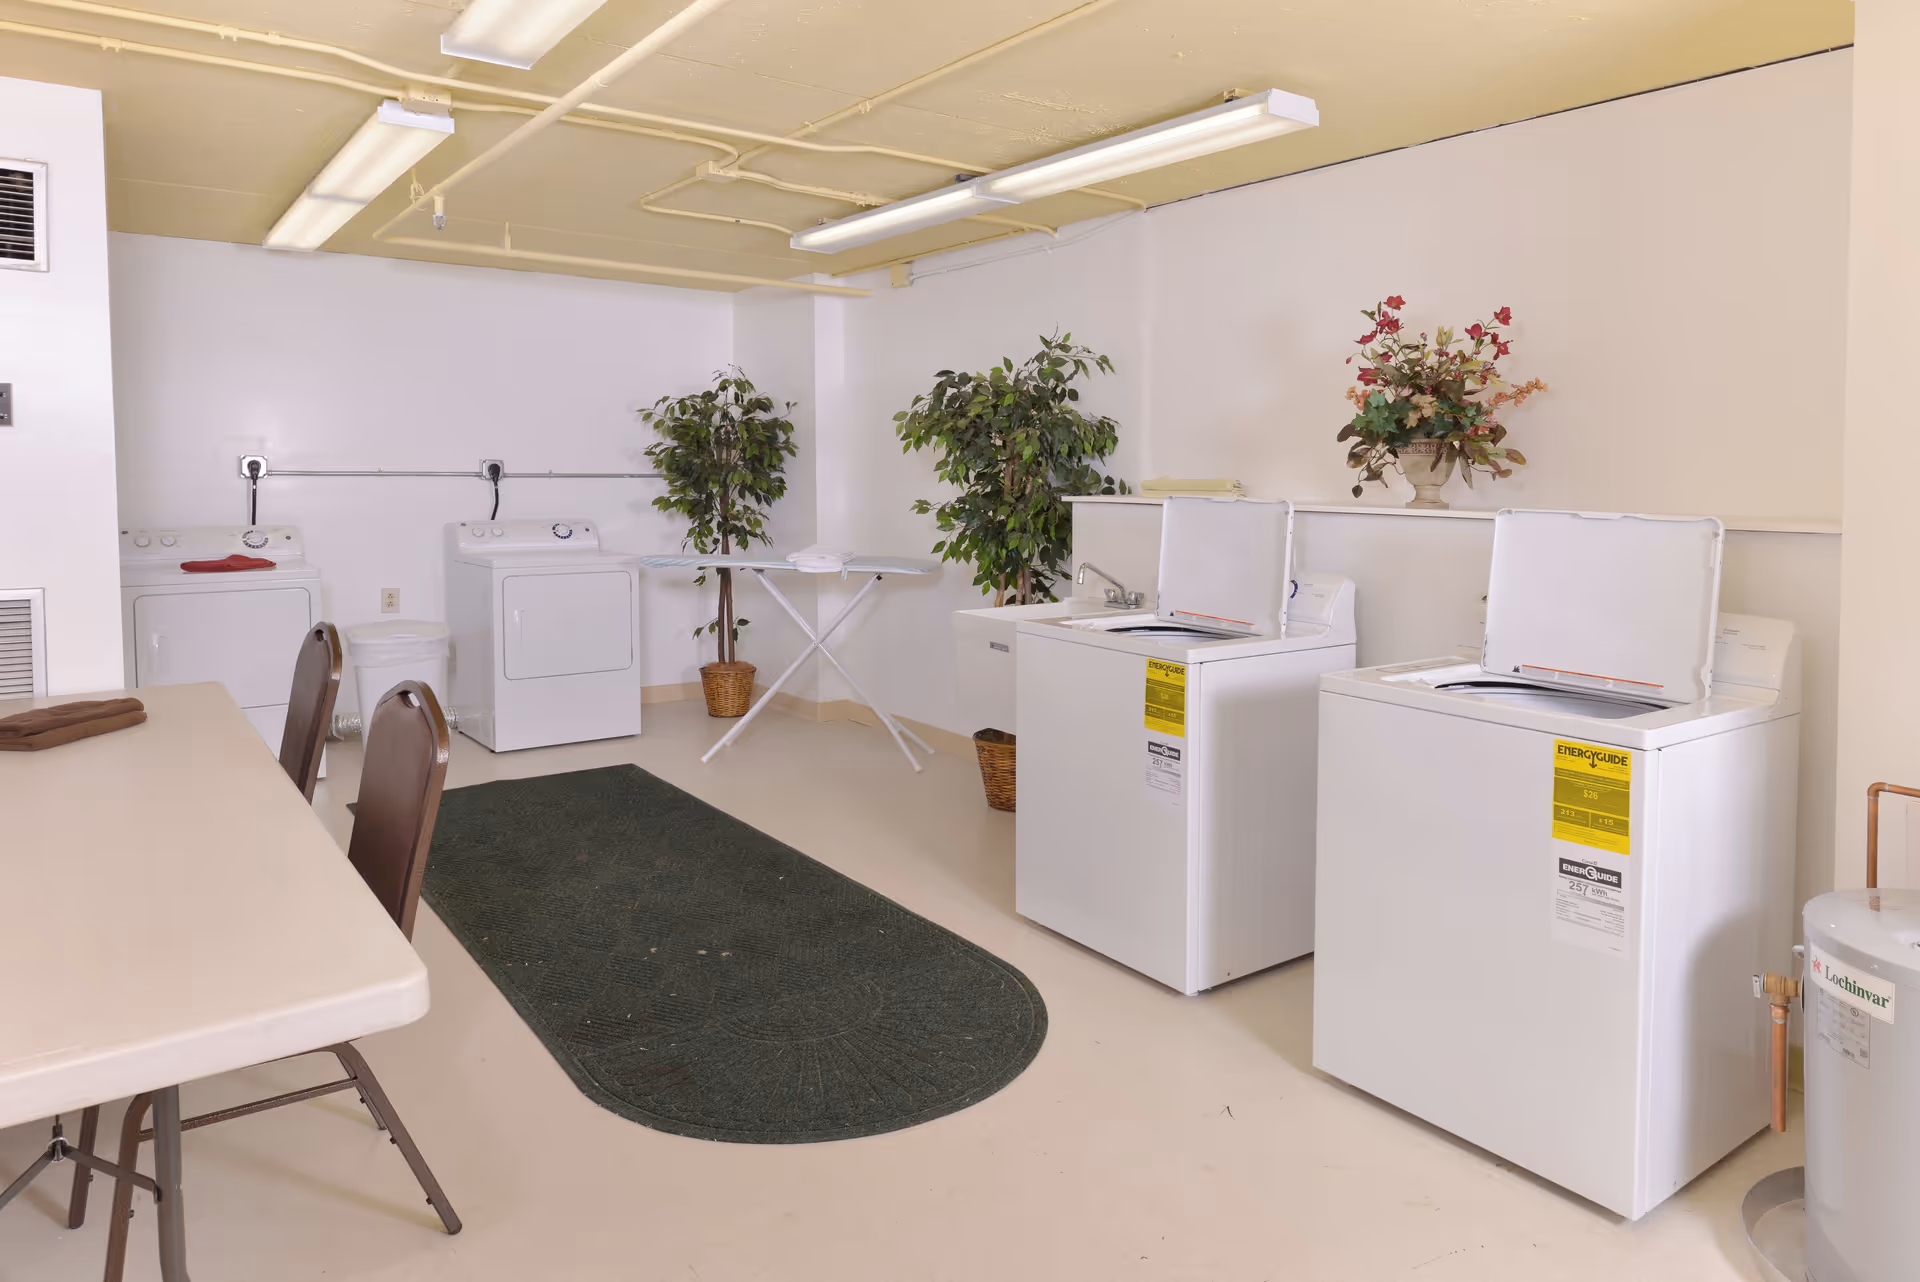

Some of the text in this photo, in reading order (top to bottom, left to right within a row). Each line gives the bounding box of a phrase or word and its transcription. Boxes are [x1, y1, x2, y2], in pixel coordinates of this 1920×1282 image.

[1148, 660, 1185, 677] ENERGYGUIDE
[1152, 757, 1163, 768] 257
[1557, 744, 1628, 768] ENERGYGUIDE
[1583, 789, 1599, 800] $26
[1562, 863, 1619, 884] ENERGUIDE
[1568, 880, 1589, 894] 257
[1591, 887, 1608, 897] kWh
[1825, 964, 1890, 1008] Lochinvar
